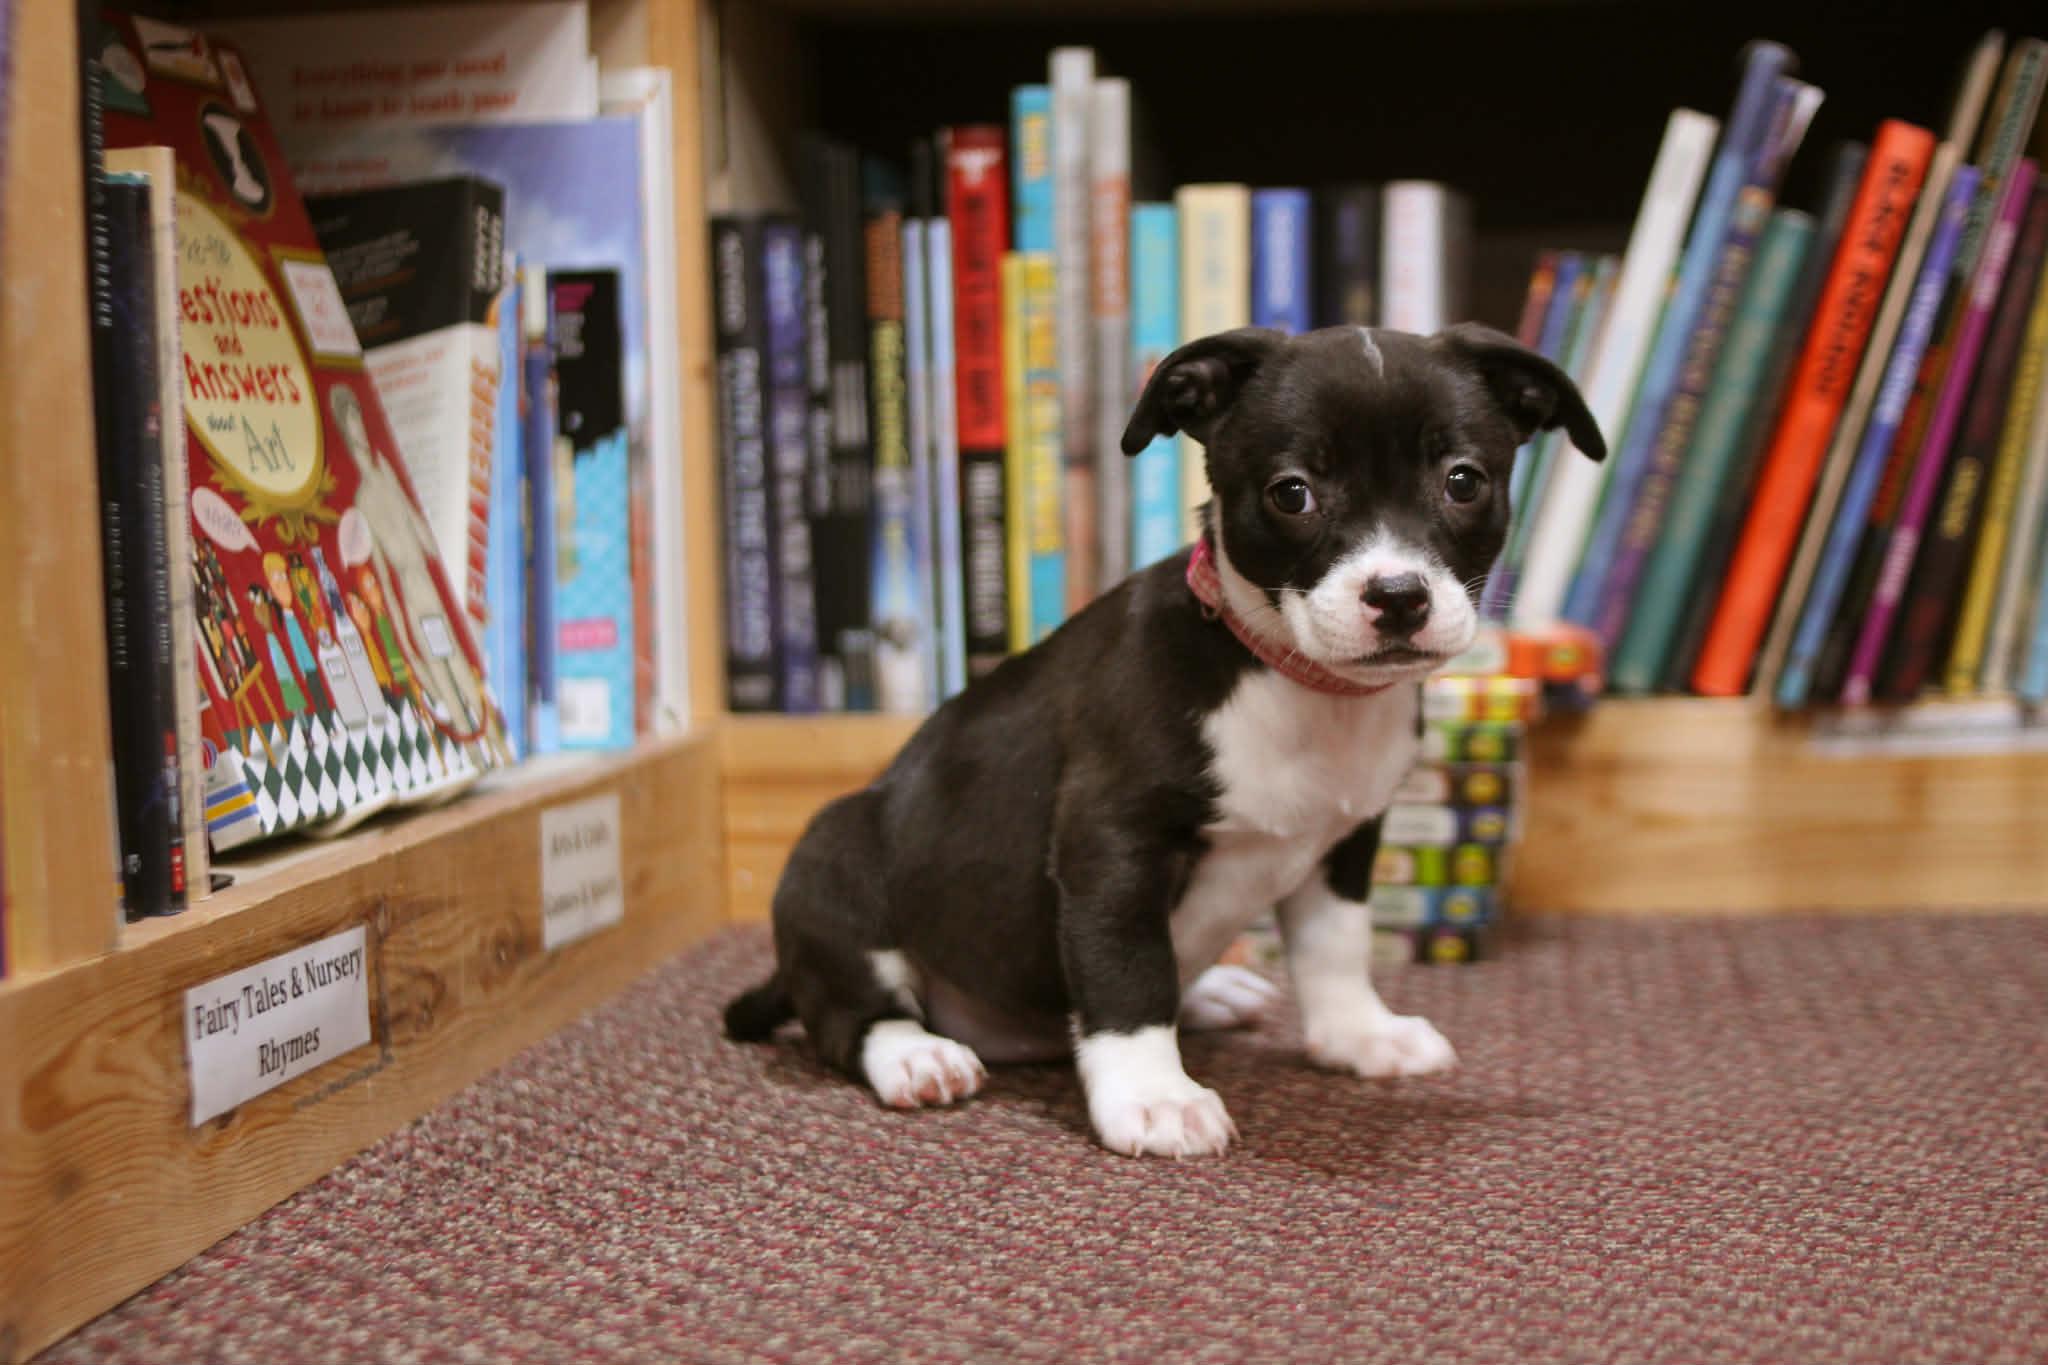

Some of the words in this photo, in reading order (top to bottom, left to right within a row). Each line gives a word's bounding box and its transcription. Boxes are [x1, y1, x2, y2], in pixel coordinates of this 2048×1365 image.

[178, 276, 280, 331] estions
[214, 330, 244, 357] and
[184, 353, 301, 404] Answers
[241, 412, 296, 473] Art
[194, 997, 241, 1041] Fairy
[243, 977, 288, 1019] Tales
[290, 966, 304, 998] &
[304, 946, 363, 993] Nursery
[258, 1027, 321, 1078] Rhymes
